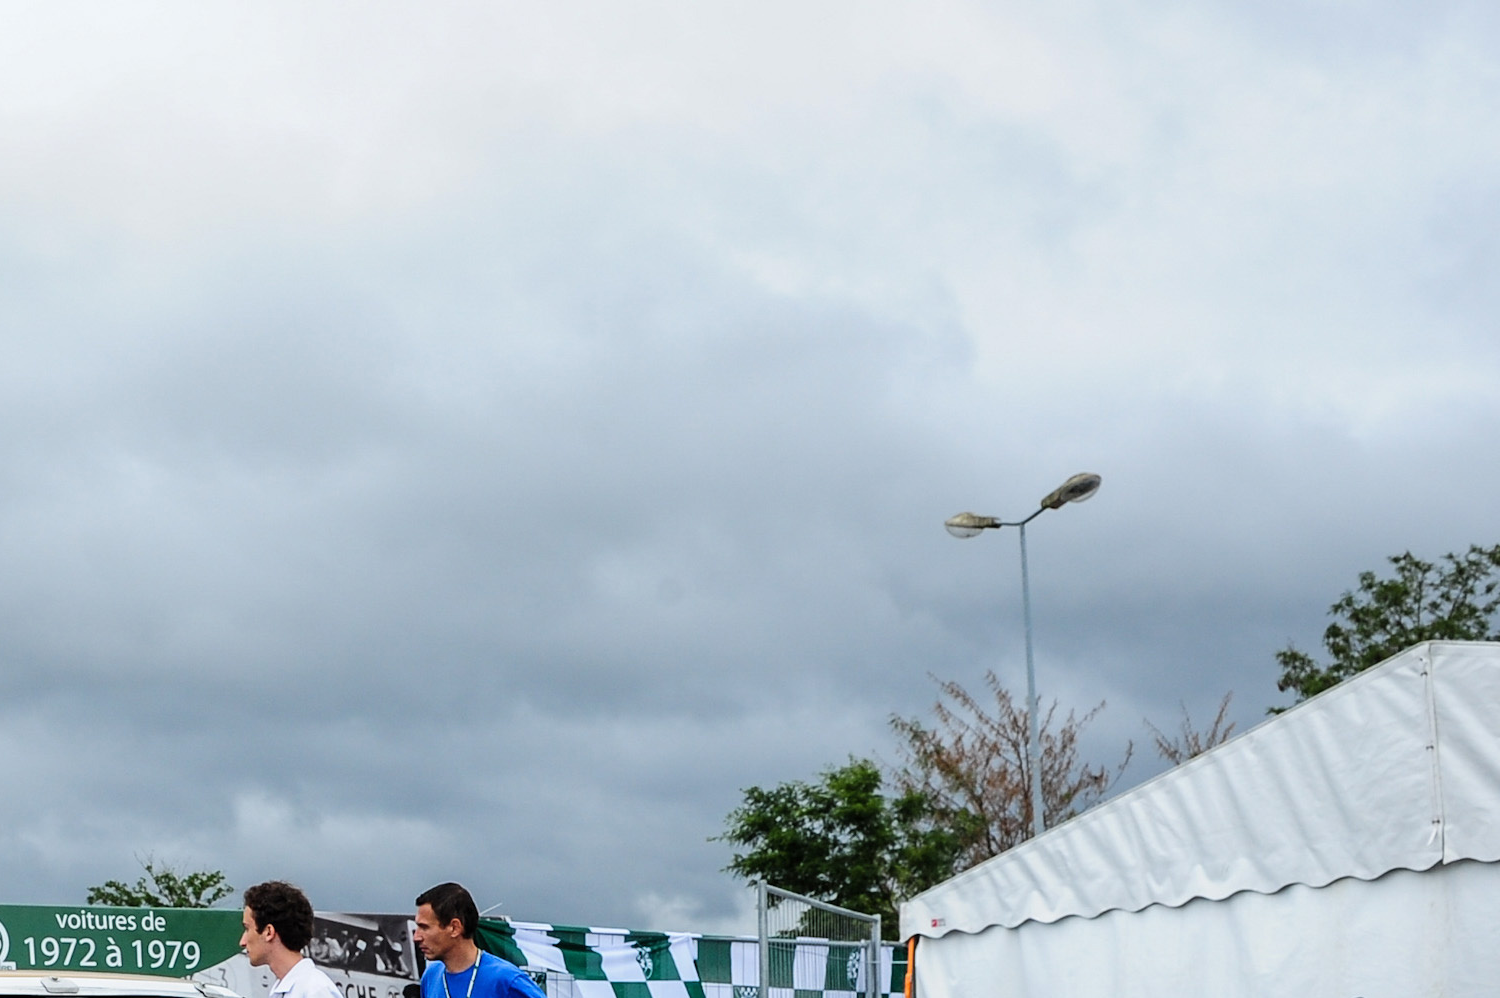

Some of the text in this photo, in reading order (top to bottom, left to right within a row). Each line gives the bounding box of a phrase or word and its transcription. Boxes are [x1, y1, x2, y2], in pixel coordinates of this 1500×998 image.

[55, 910, 166, 932] voitures de
[24, 937, 201, 970] 1972 à 1979
